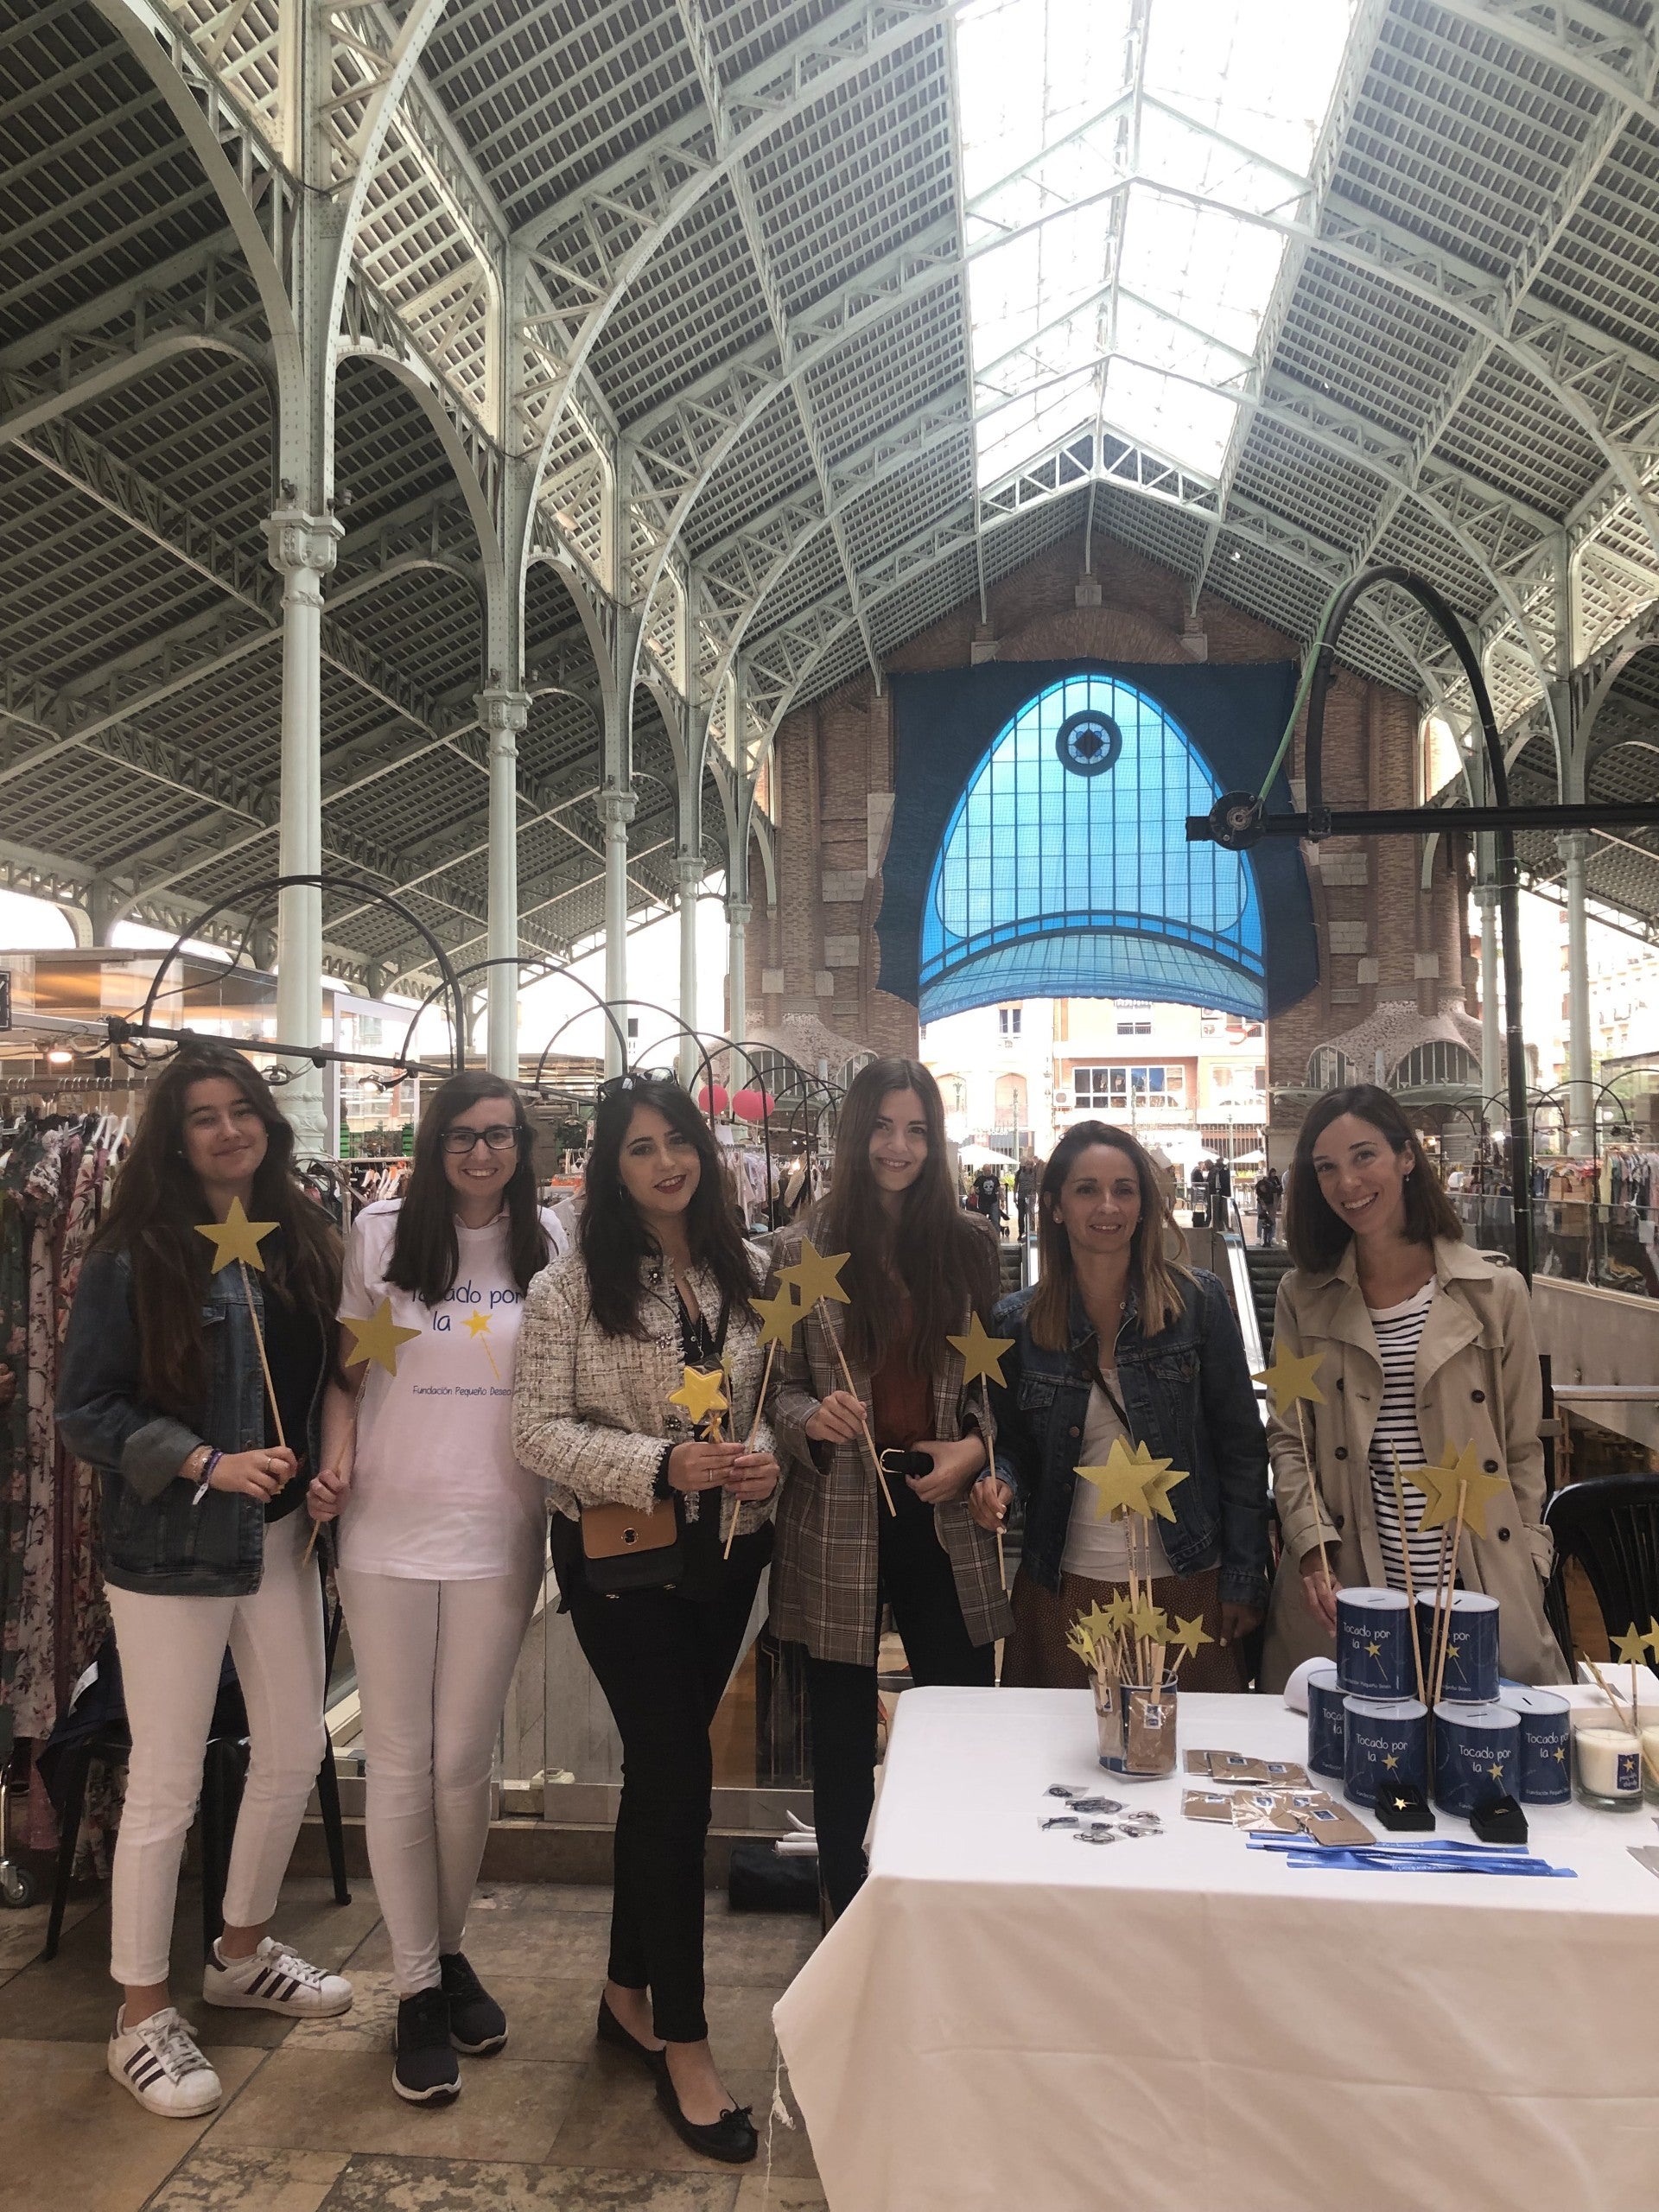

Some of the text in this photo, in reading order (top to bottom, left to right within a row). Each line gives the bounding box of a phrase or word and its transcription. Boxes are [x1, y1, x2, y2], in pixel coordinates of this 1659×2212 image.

[490, 1288, 521, 1309] por
[433, 1310, 451, 1331] la
[412, 1385, 512, 1397] Fundación Pequeño Deseo
[1343, 1622, 1391, 1641] Tocado por
[1452, 1632, 1471, 1643] por
[1352, 1638, 1360, 1649] la
[1333, 1723, 1343, 1735] la
[1356, 1733, 1408, 1753] Tocado por
[1525, 1732, 1559, 1745] Tocado
[1368, 1751, 1377, 1762] la
[1459, 1745, 1512, 1763] Tocado por
[1540, 1747, 1549, 1758] la
[1472, 1761, 1483, 1773] la
